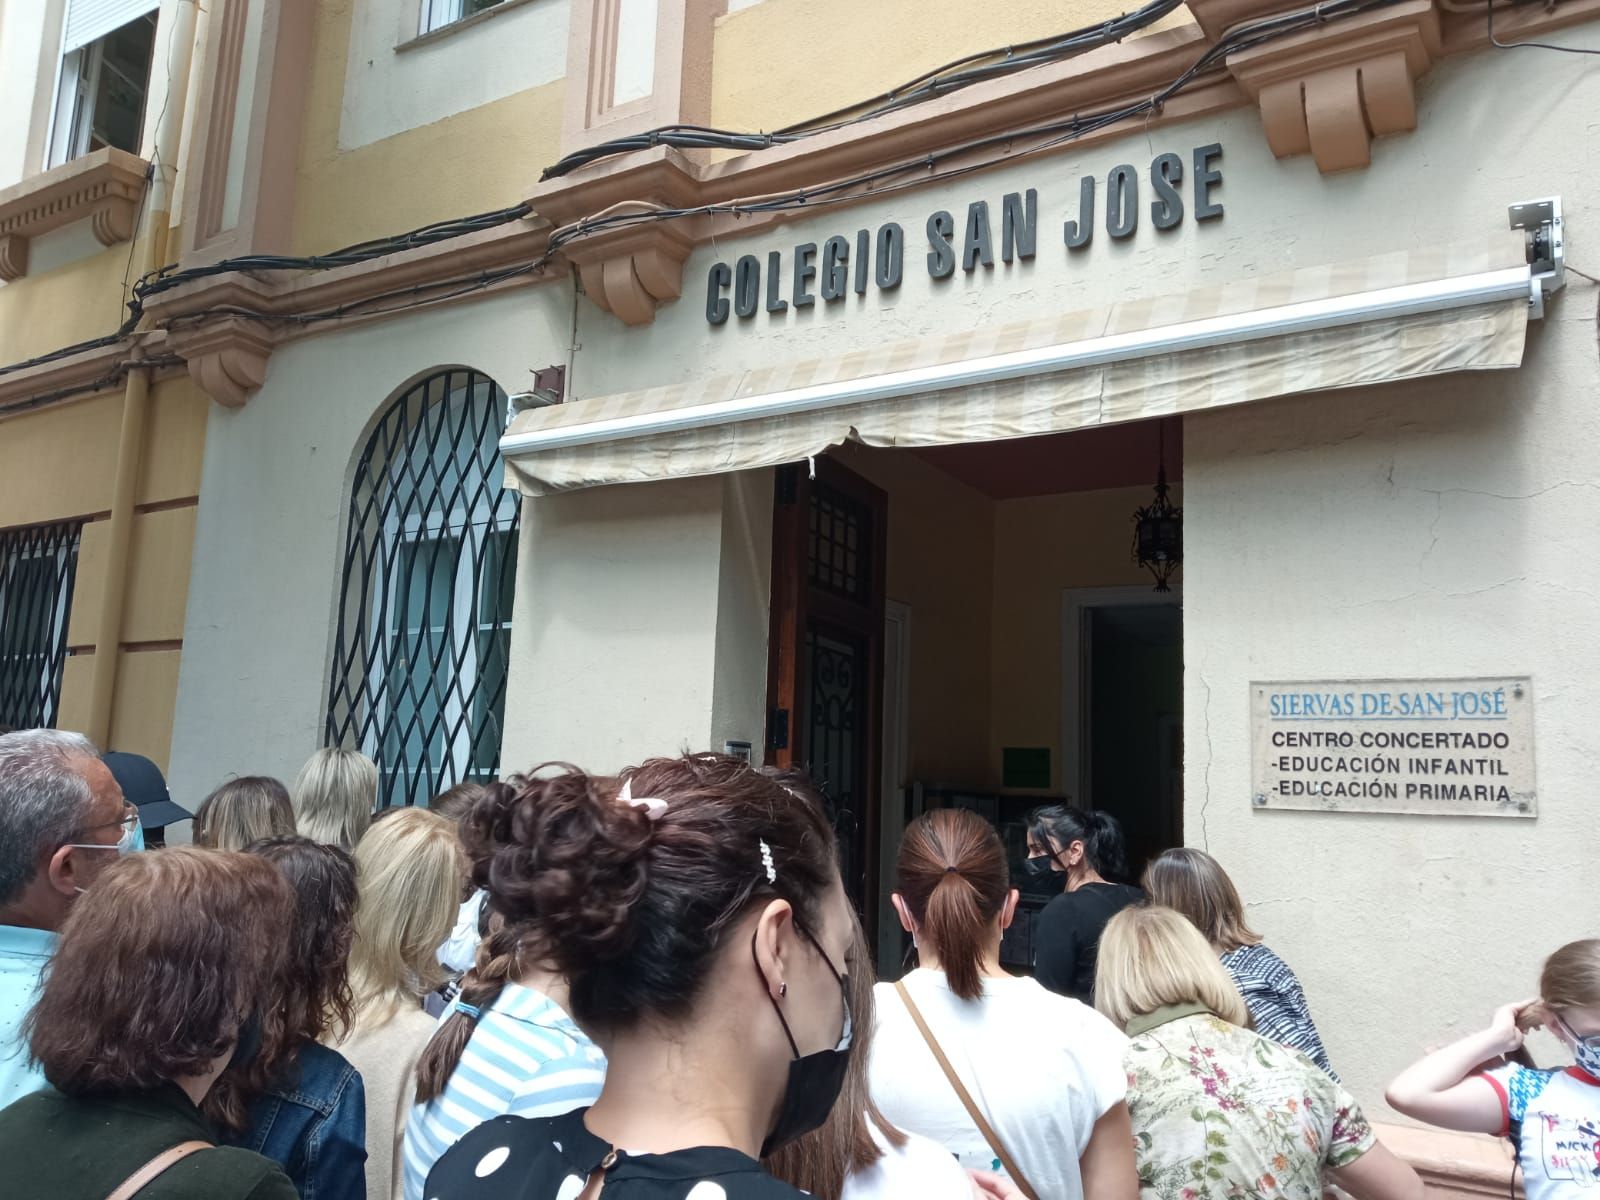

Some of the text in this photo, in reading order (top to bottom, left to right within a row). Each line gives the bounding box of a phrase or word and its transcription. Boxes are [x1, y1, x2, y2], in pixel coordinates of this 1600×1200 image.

[705, 143, 1224, 325] COLEGIO SAN JOSE
[1270, 688, 1508, 720] SIERVAS DE SAN JOSÉ
[1272, 732, 1510, 749] CENTRO CONCERTADO
[1272, 754, 1509, 776] -EDUCACIÓN INFANTIL
[1272, 779, 1511, 802] -EDUCACIÓN PRIMARIA
